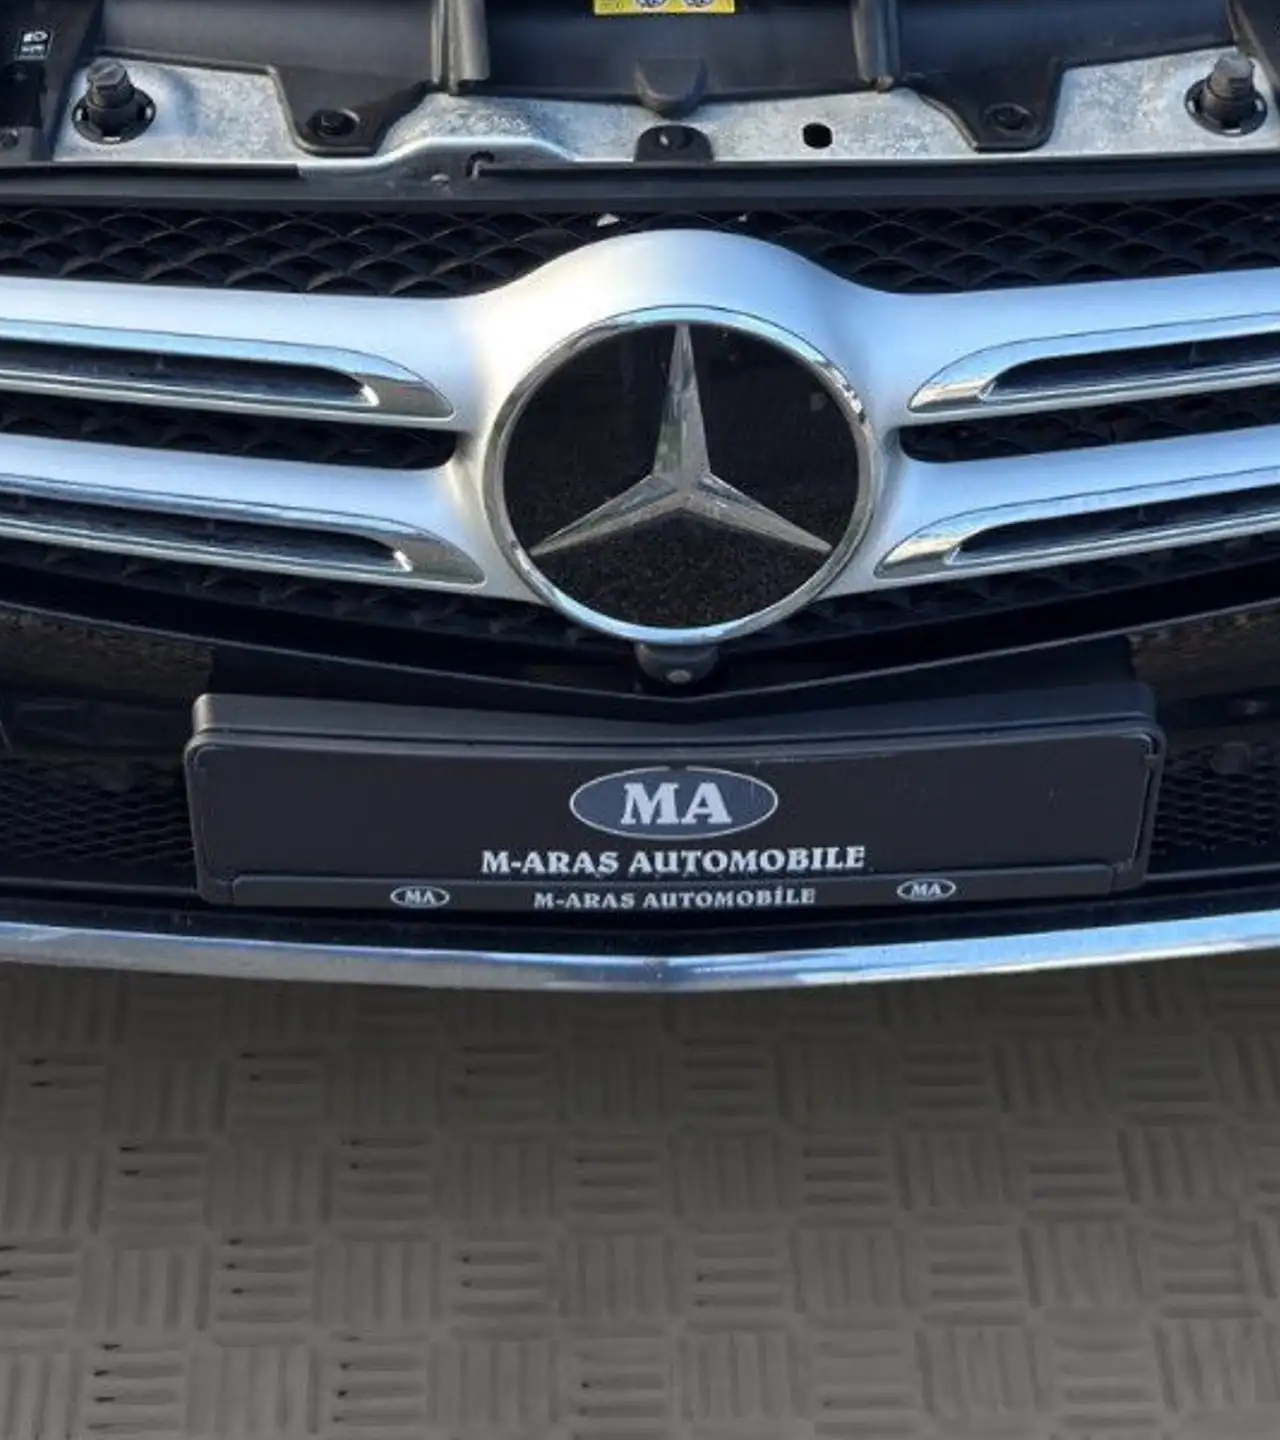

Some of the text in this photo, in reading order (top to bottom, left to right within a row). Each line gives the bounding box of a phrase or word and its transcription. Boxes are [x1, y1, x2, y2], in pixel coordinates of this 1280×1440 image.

[620, 782, 732, 825] MA
[481, 845, 866, 875] M-ARAS AUTOMOBILE
[534, 892, 635, 910] M-ARAS
